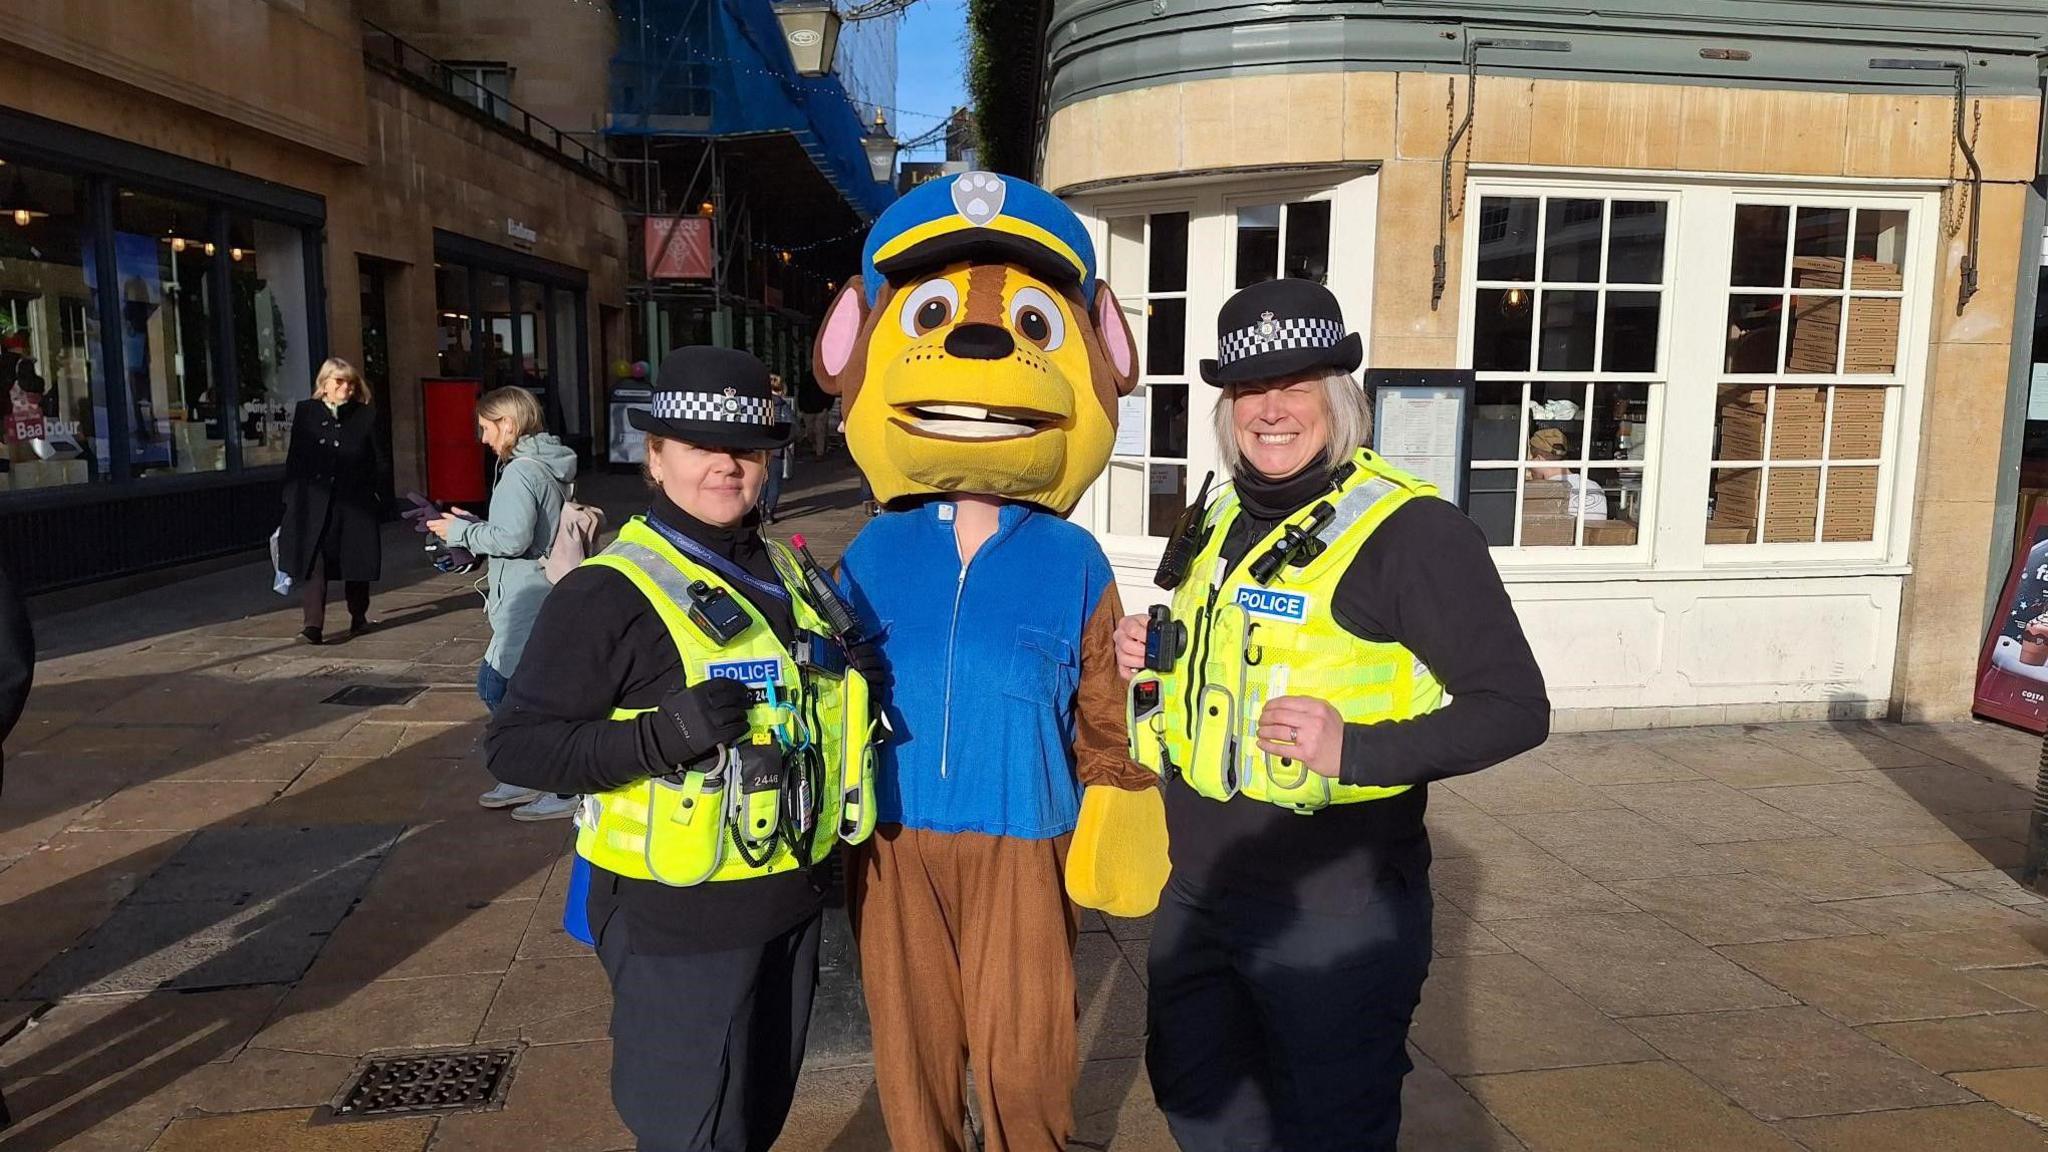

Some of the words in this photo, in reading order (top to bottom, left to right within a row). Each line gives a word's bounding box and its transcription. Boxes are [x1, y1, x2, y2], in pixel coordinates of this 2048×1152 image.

[1239, 592, 1300, 614] POLICE
[714, 664, 775, 680] POLICE
[2021, 690, 2044, 702] COSTA
